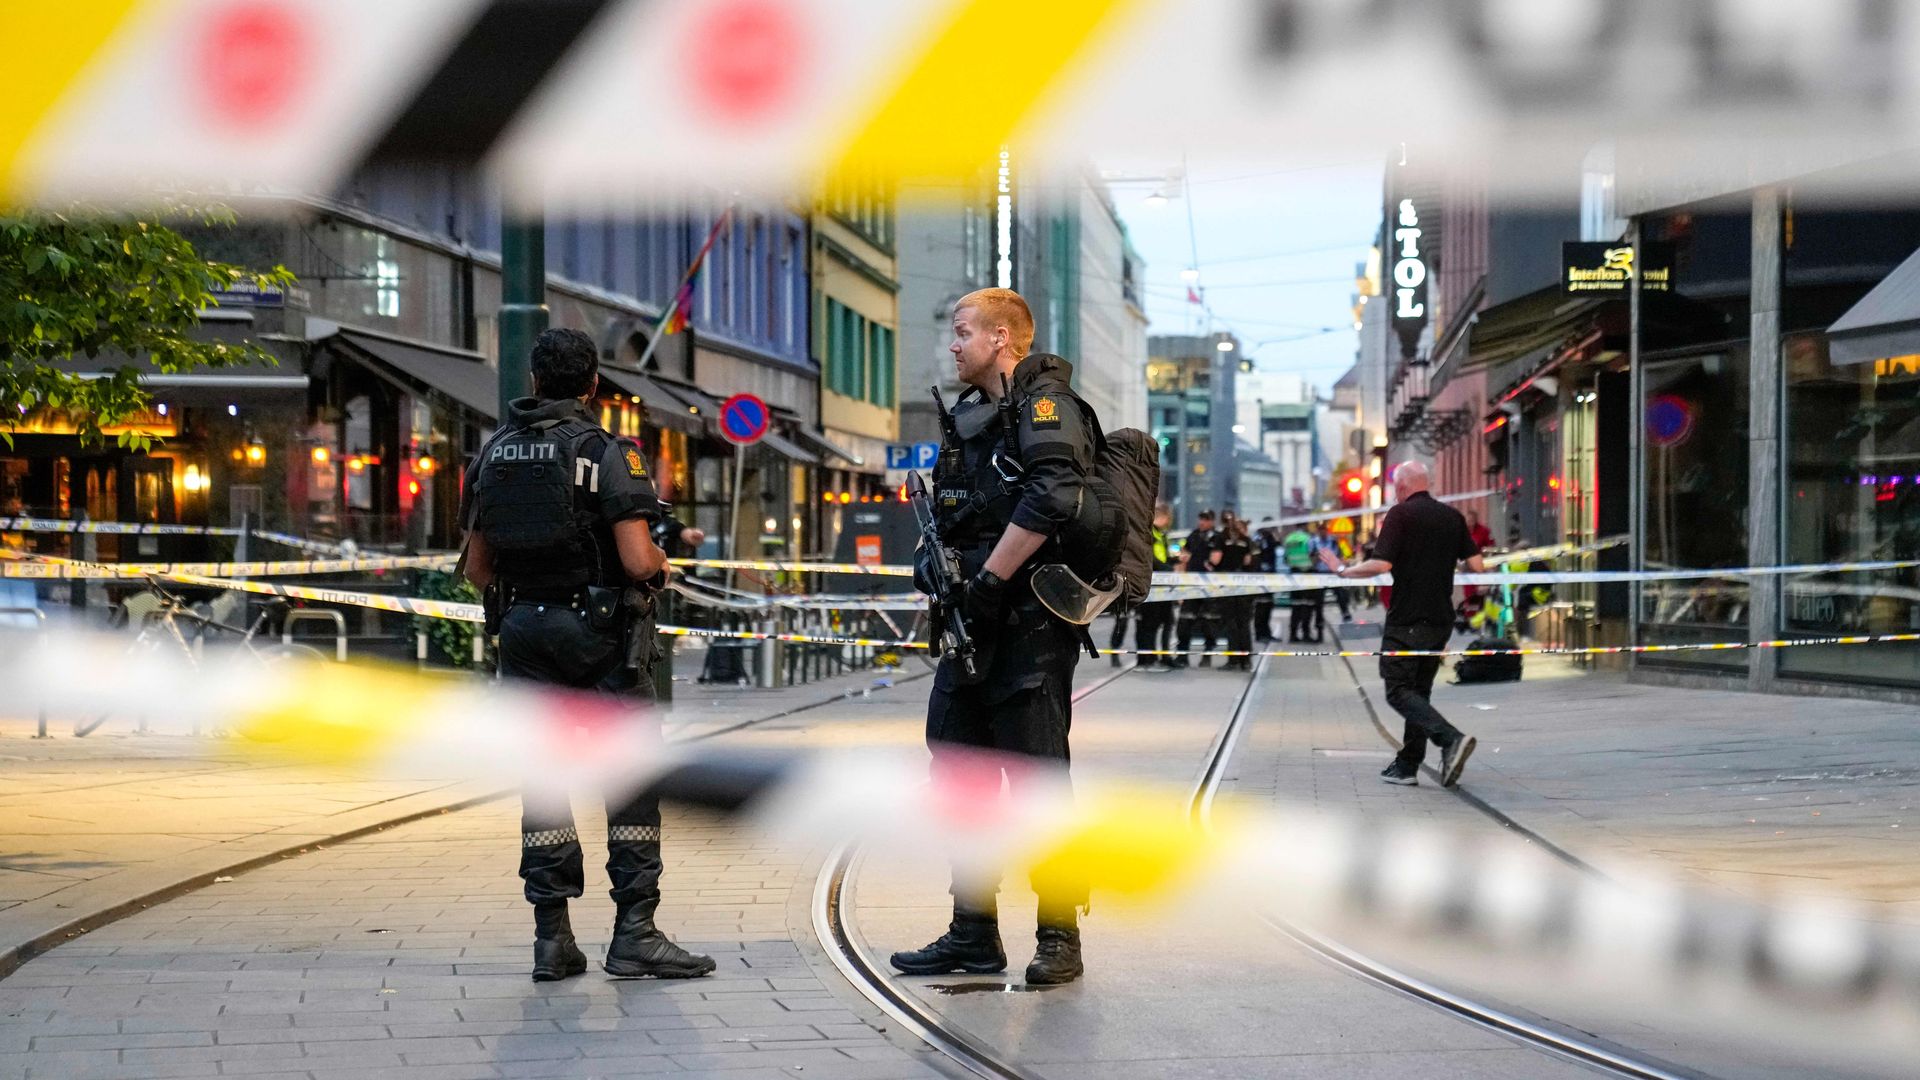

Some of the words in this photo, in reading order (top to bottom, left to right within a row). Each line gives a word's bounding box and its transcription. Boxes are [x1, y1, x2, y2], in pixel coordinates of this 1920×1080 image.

[1568, 266, 1625, 281] Interflora
[490, 443, 555, 462] POLITI
[892, 448, 908, 467] P
[918, 447, 934, 467] P
[940, 489, 967, 498] POLITI
